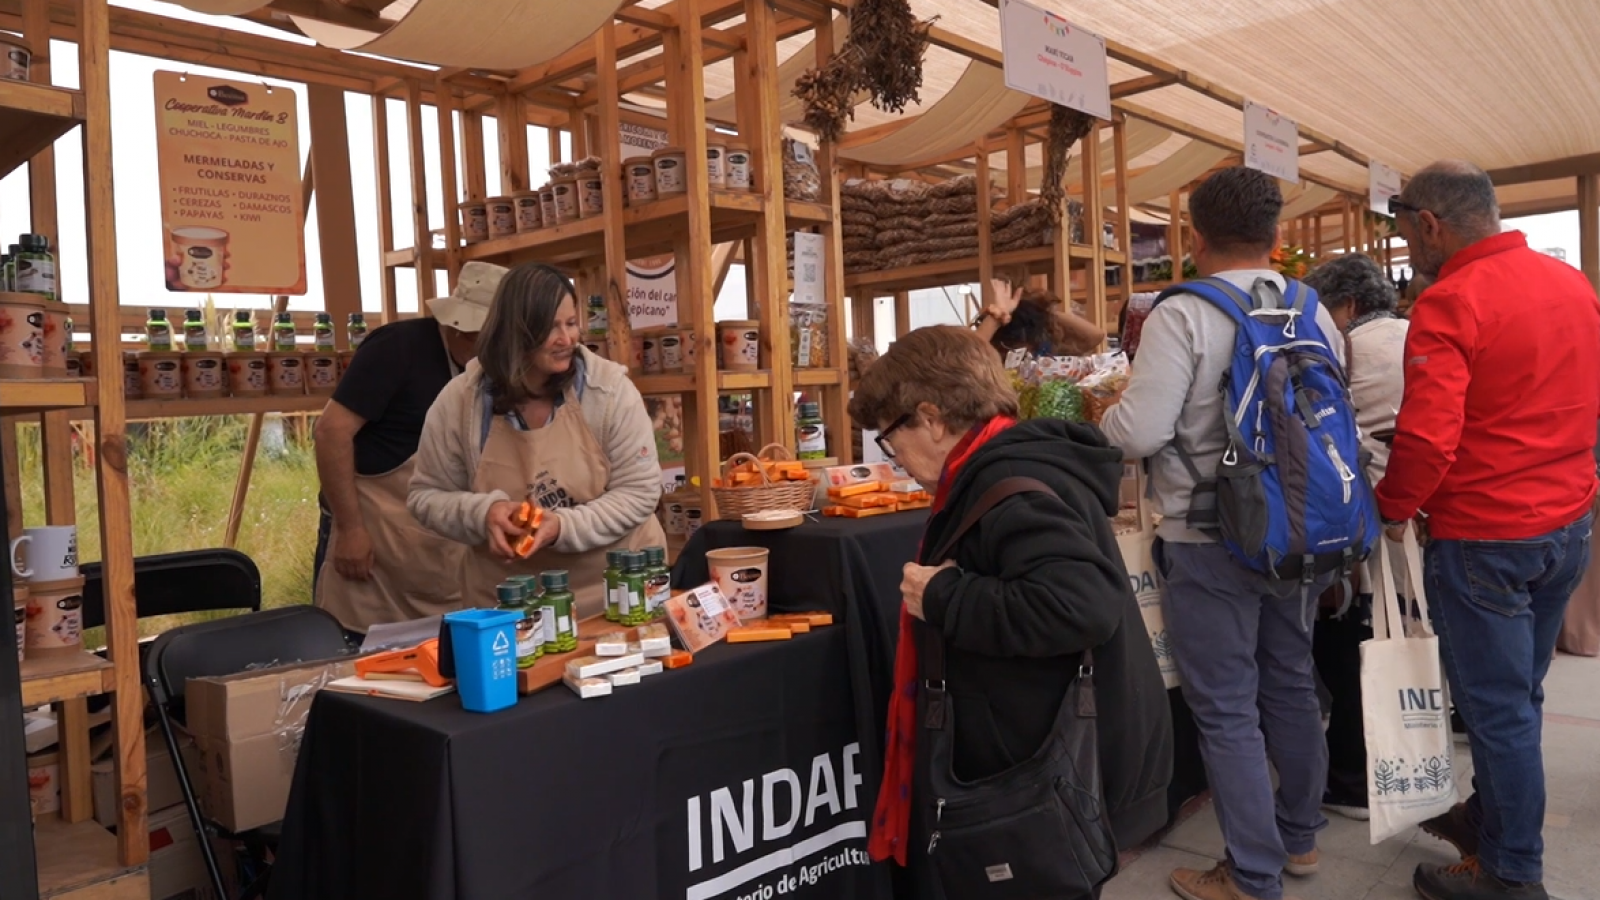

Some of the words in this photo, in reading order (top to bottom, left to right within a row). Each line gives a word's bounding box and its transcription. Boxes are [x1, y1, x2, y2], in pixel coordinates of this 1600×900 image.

[165, 98, 227, 117] Cooperativa
[188, 119, 209, 129] MIEL
[216, 123, 270, 136] LEGUMBRES
[229, 134, 257, 145] PASTA
[259, 137, 271, 146] DE
[273, 139, 288, 148] AJO
[183, 154, 265, 171] MERMELADAS
[267, 162, 275, 172] Y
[197, 168, 267, 185] CONSERVAS
[178, 186, 230, 198] FRUTILLAS
[238, 191, 291, 203] DURAZNOS
[179, 197, 222, 208] CEREZAS
[239, 202, 292, 214] DAMASCOS
[180, 209, 225, 220] PAPAYAS
[240, 213, 261, 222] KIWI
[648, 289, 662, 301] del
[776, 873, 798, 894] de
